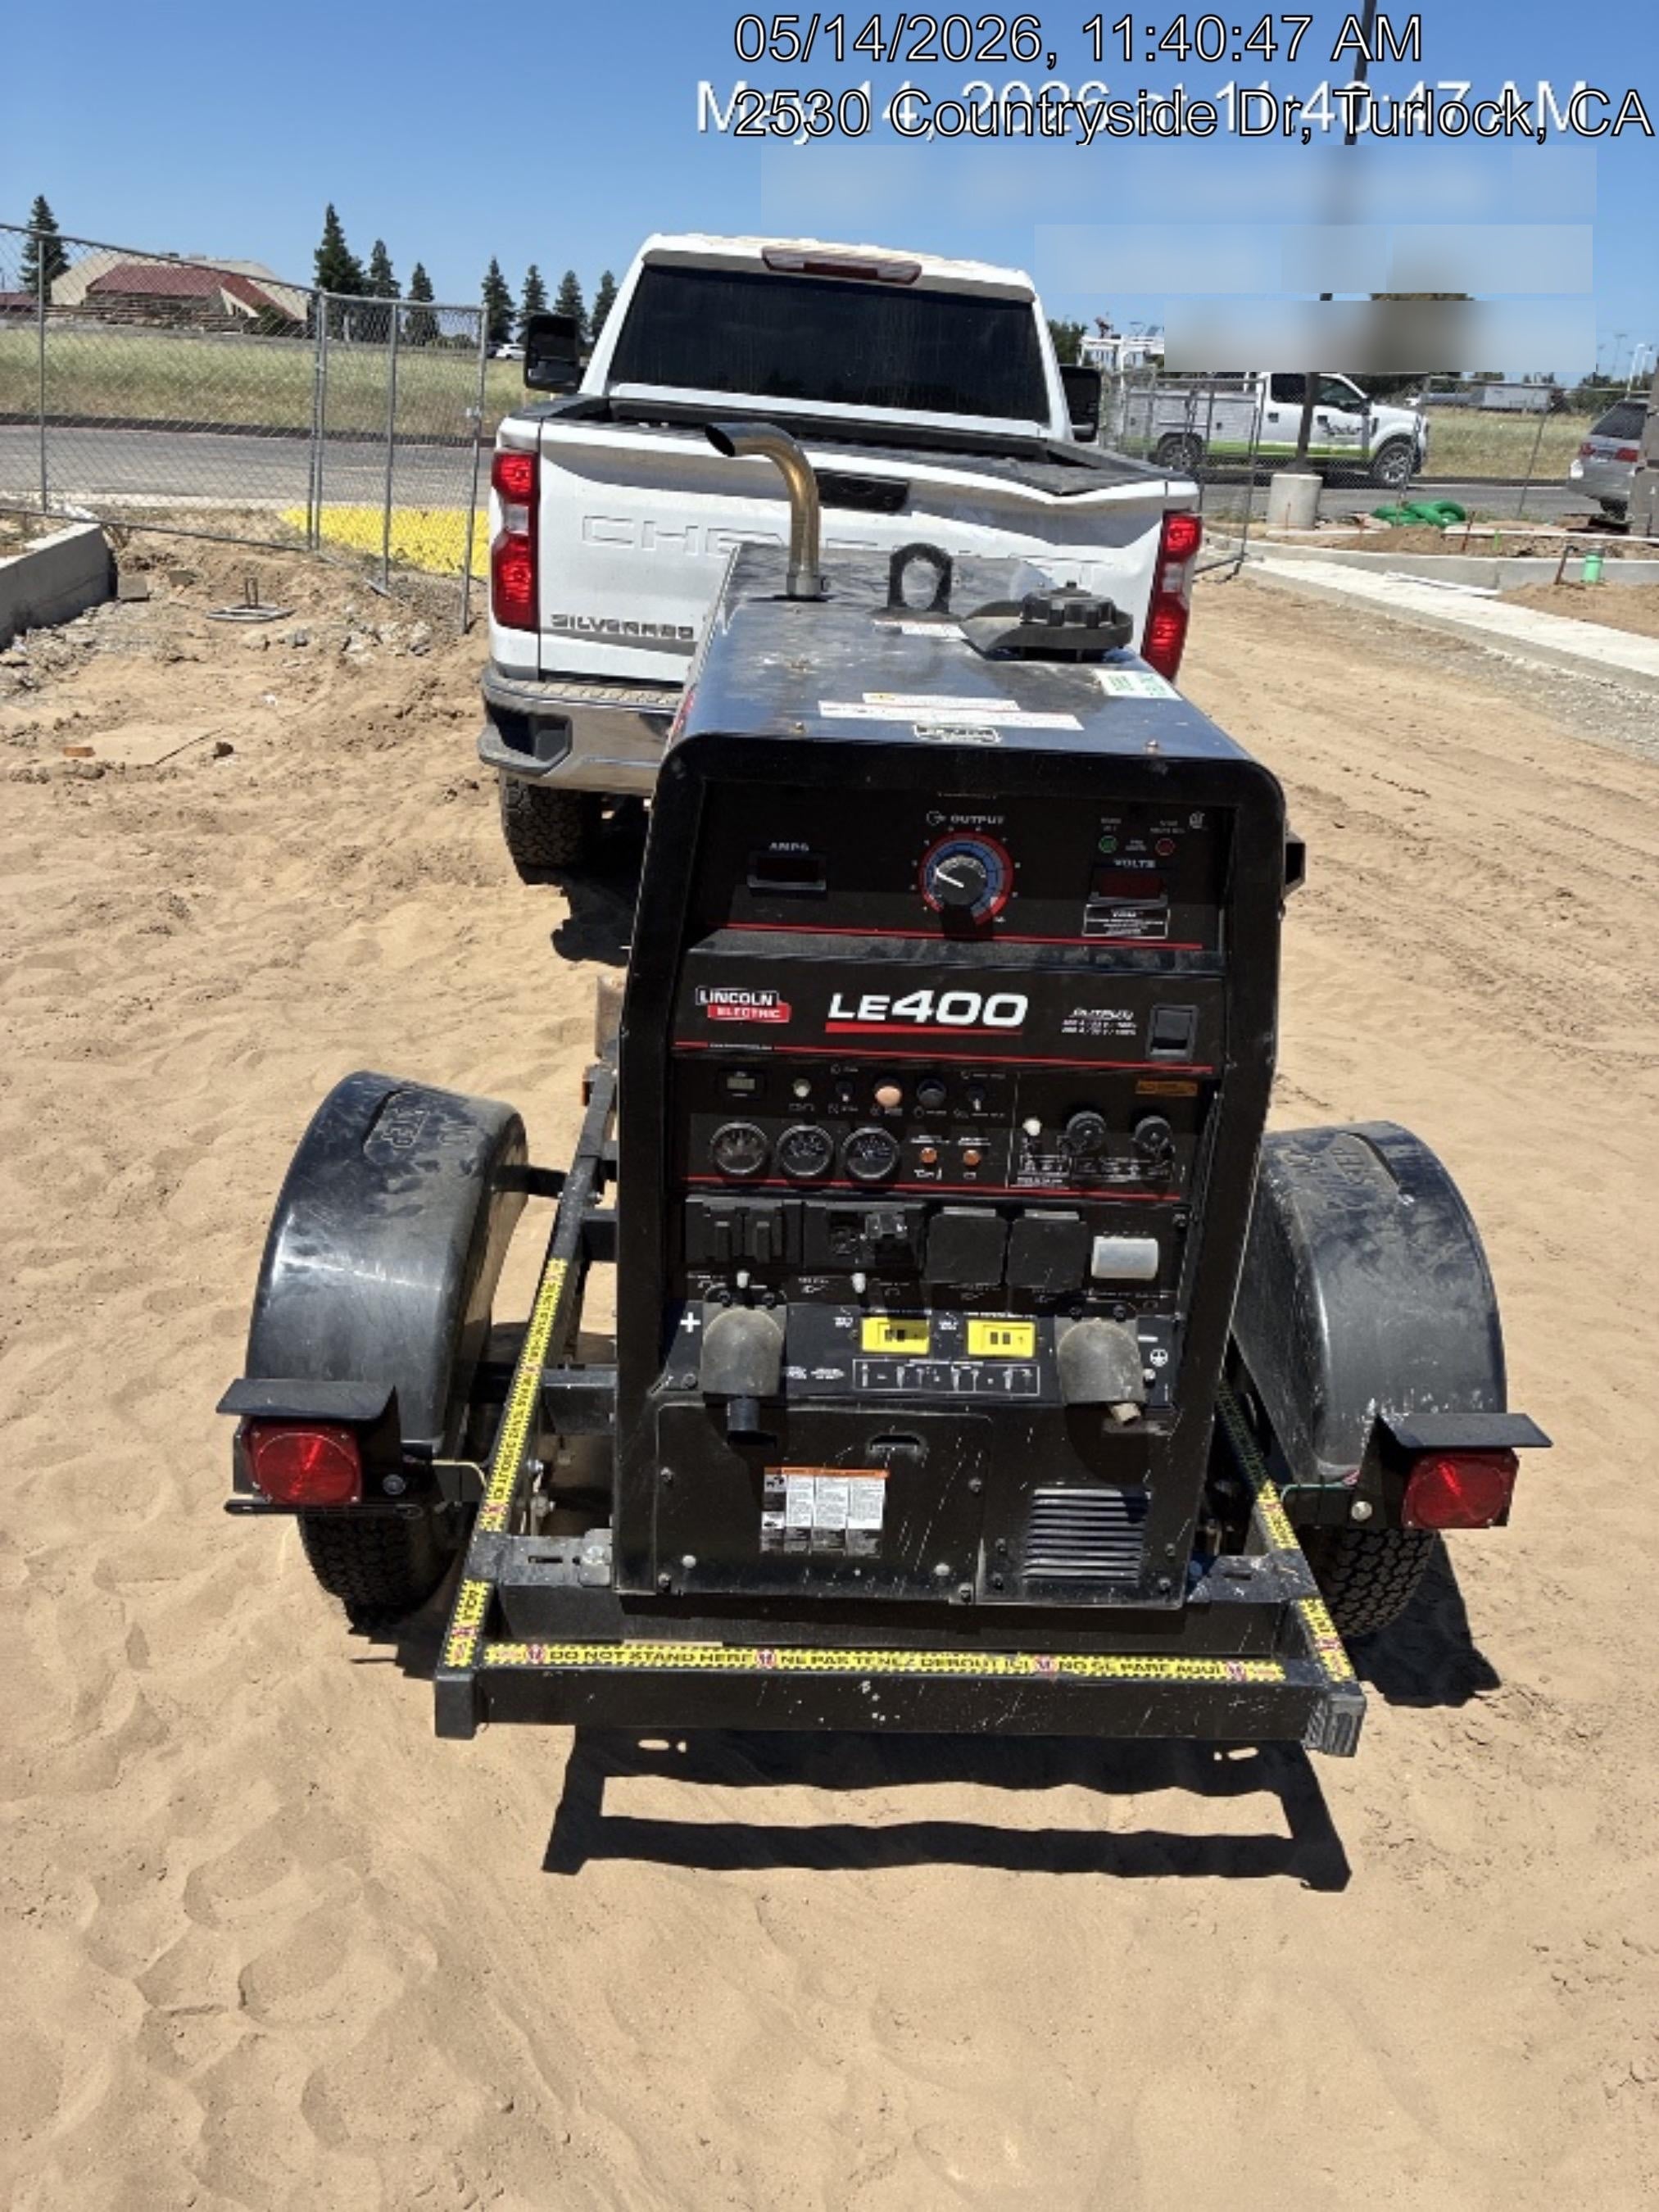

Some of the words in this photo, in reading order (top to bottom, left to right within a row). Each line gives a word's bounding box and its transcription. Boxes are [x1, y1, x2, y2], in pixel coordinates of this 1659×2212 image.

[551, 614, 693, 640] SILVERADO
[700, 990, 773, 1007] LINCOLN
[717, 1007, 781, 1018] ELECTRIC
[828, 990, 1029, 1027] LE400
[550, 1651, 575, 1661] DO
[584, 1650, 625, 1661] NOT
[781, 1655, 808, 1666] NE
